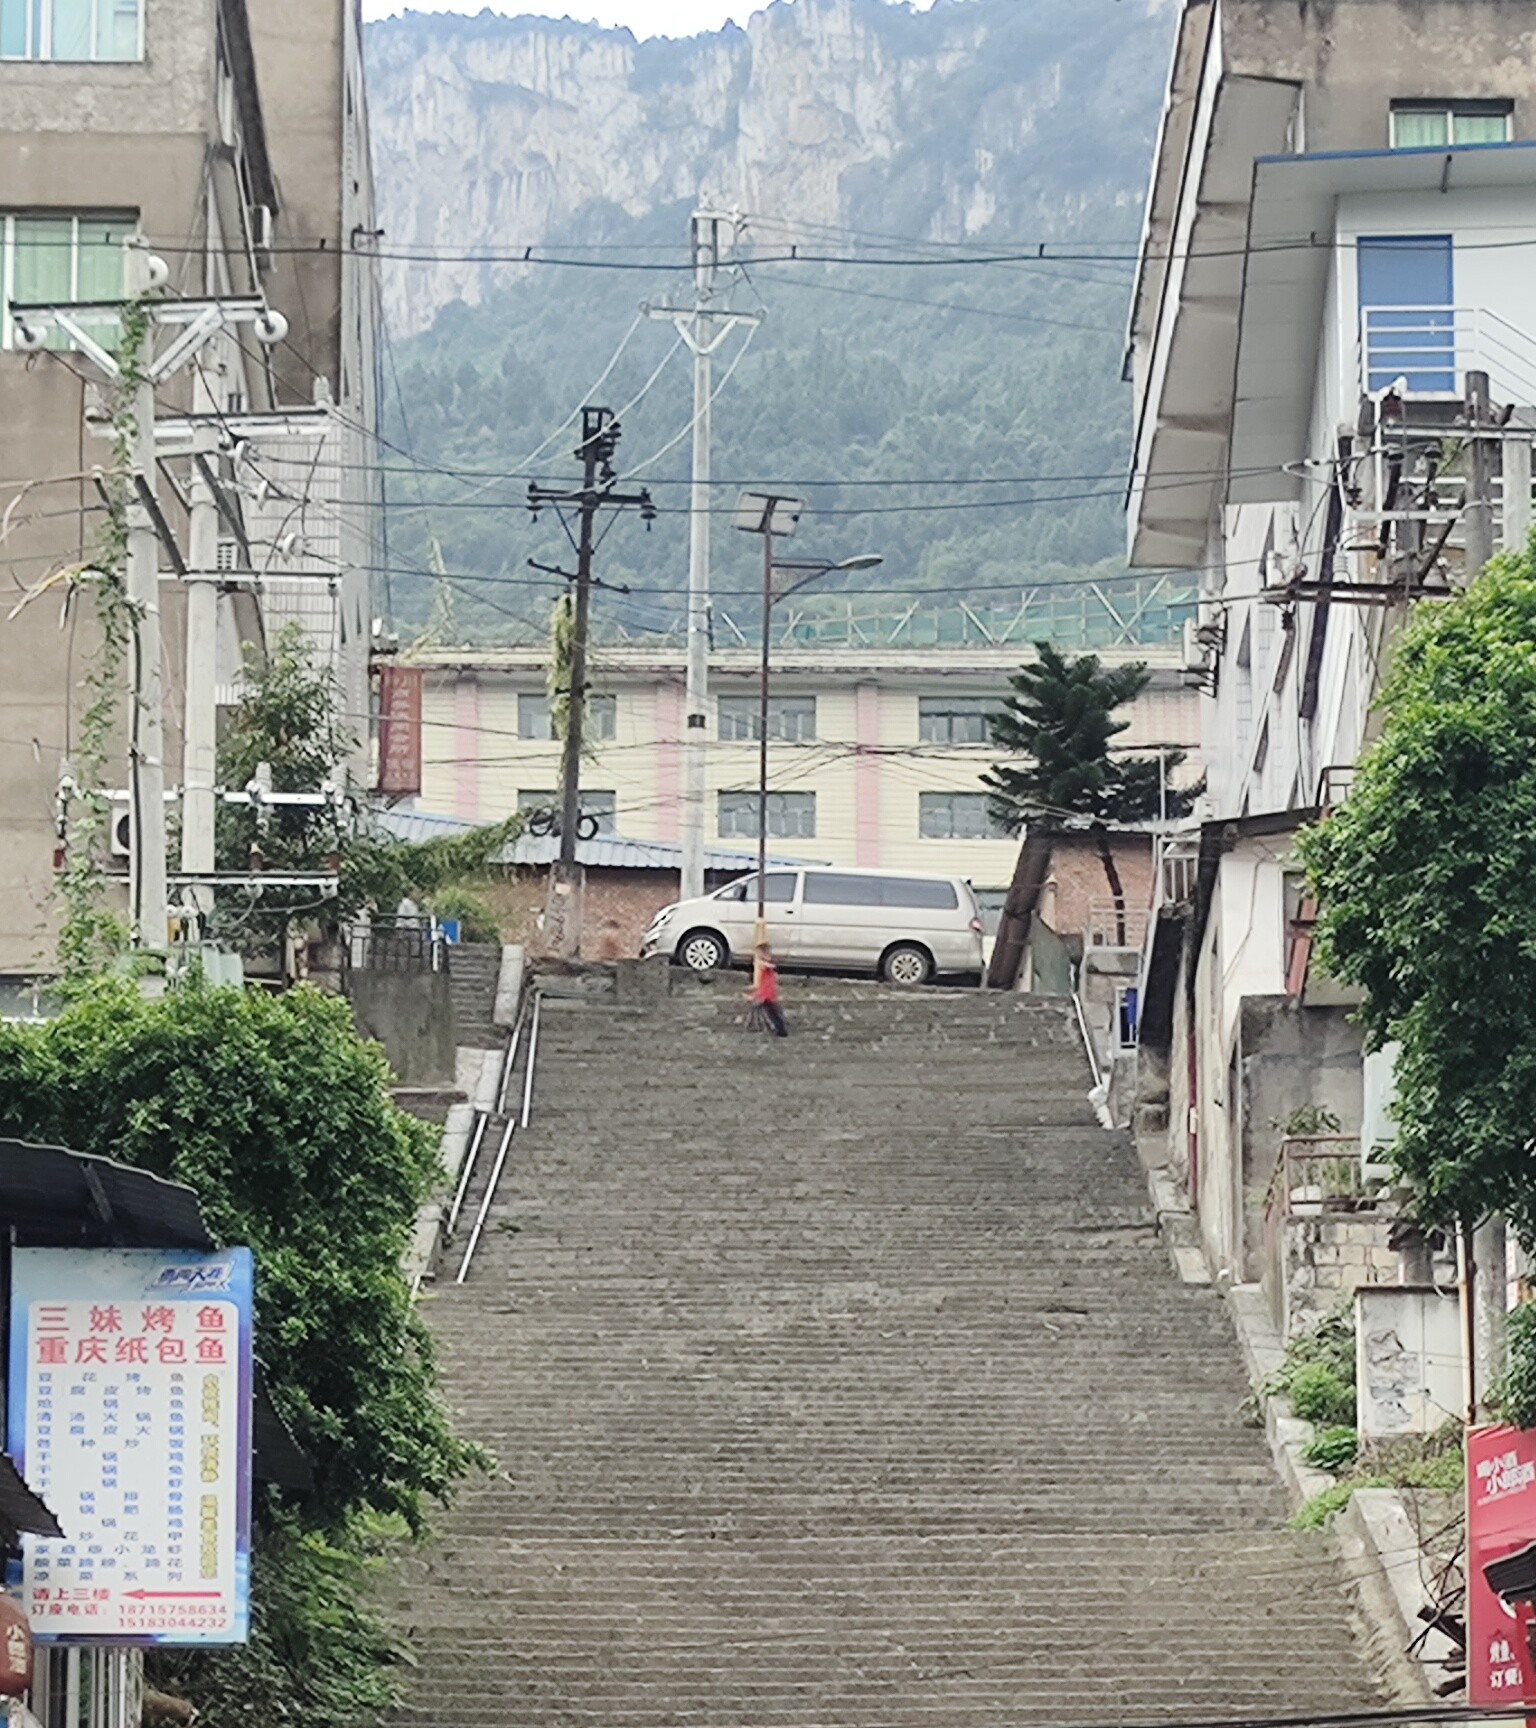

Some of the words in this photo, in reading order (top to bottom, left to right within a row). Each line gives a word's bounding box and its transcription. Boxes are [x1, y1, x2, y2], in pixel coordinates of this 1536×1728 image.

[37, 1306, 227, 1333] 三妹烤鱼
[37, 1337, 227, 1364] 重庆纸包鱼
[32, 1587, 111, 1601] 请上三楼
